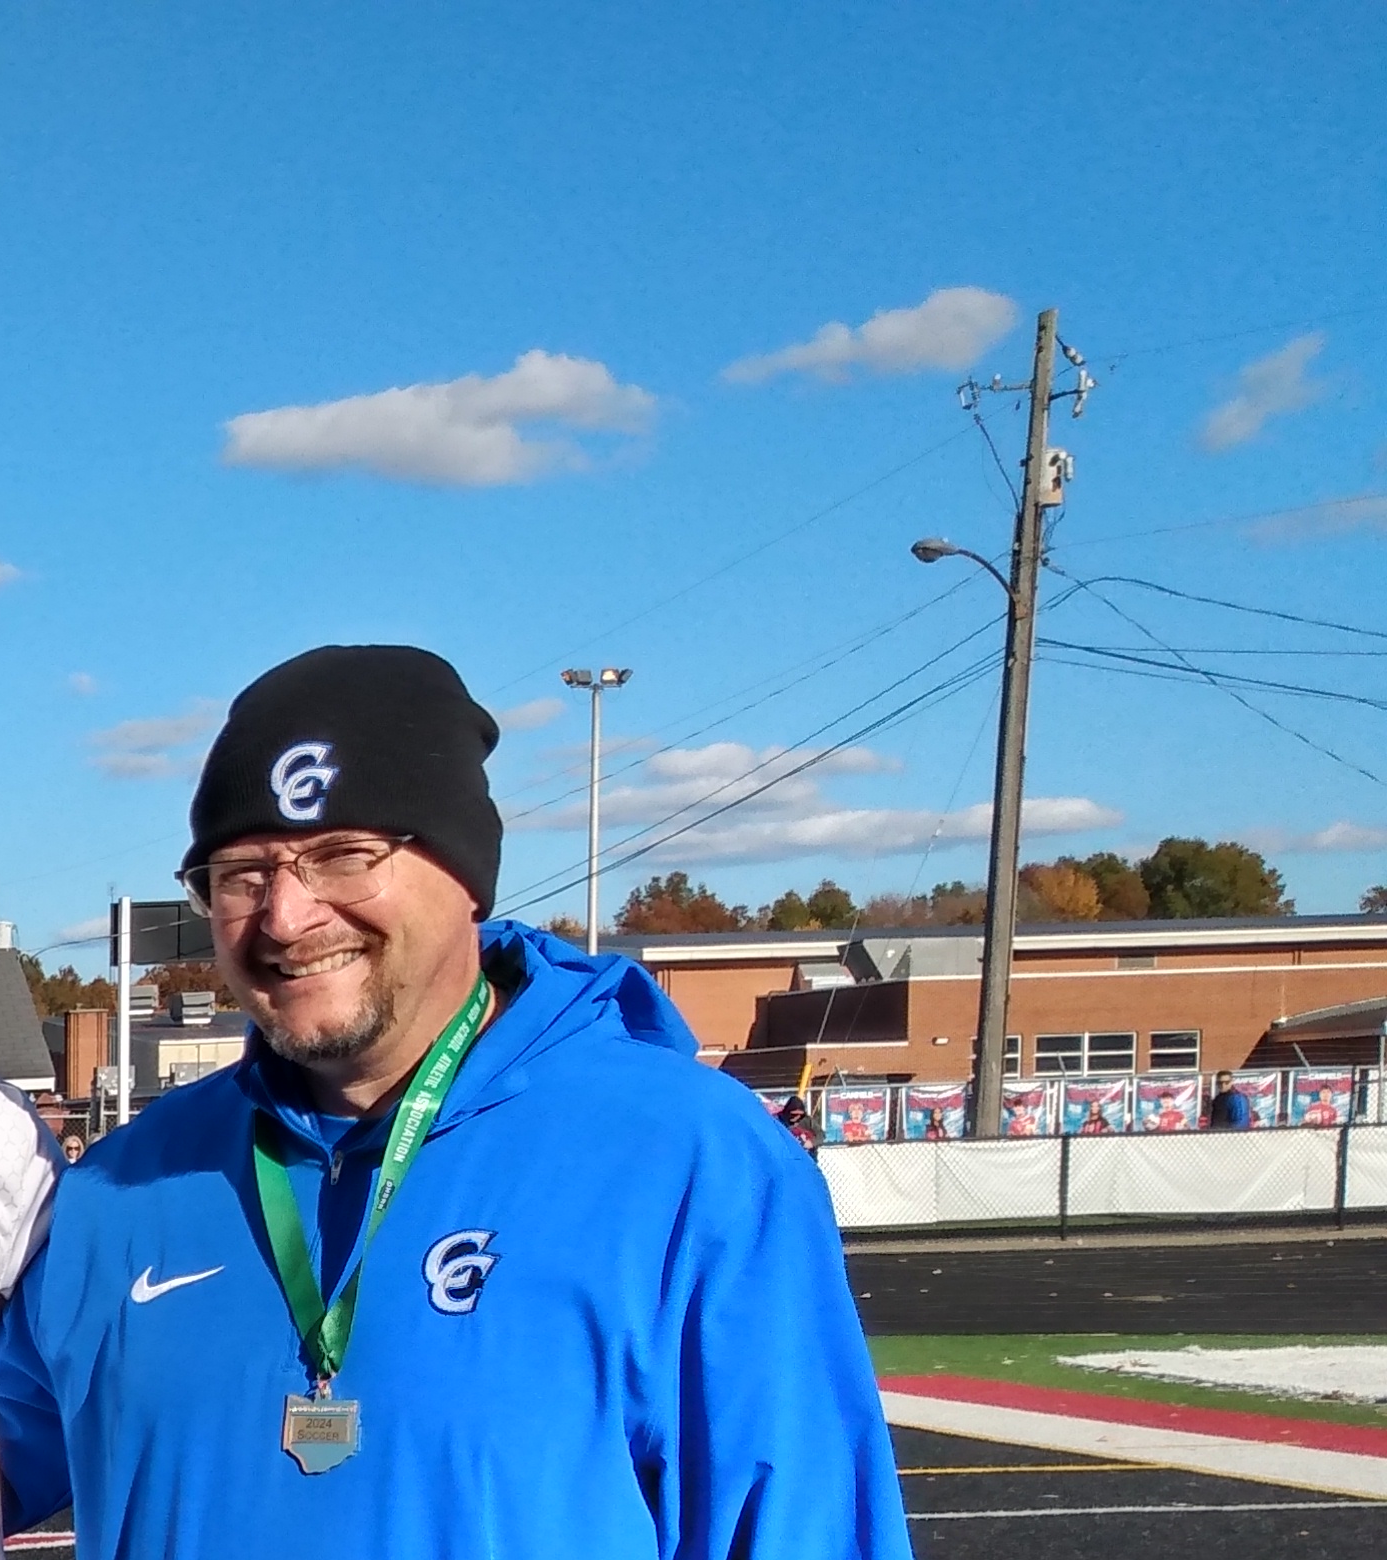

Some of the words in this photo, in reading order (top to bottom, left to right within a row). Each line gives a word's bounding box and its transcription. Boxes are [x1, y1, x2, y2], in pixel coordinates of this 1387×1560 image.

[423, 1052, 453, 1088] ATHLETIC
[393, 1090, 432, 1163] ASSOCIATION
[297, 1429, 339, 1441] SOCCER
[305, 1418, 332, 1429] 2024
